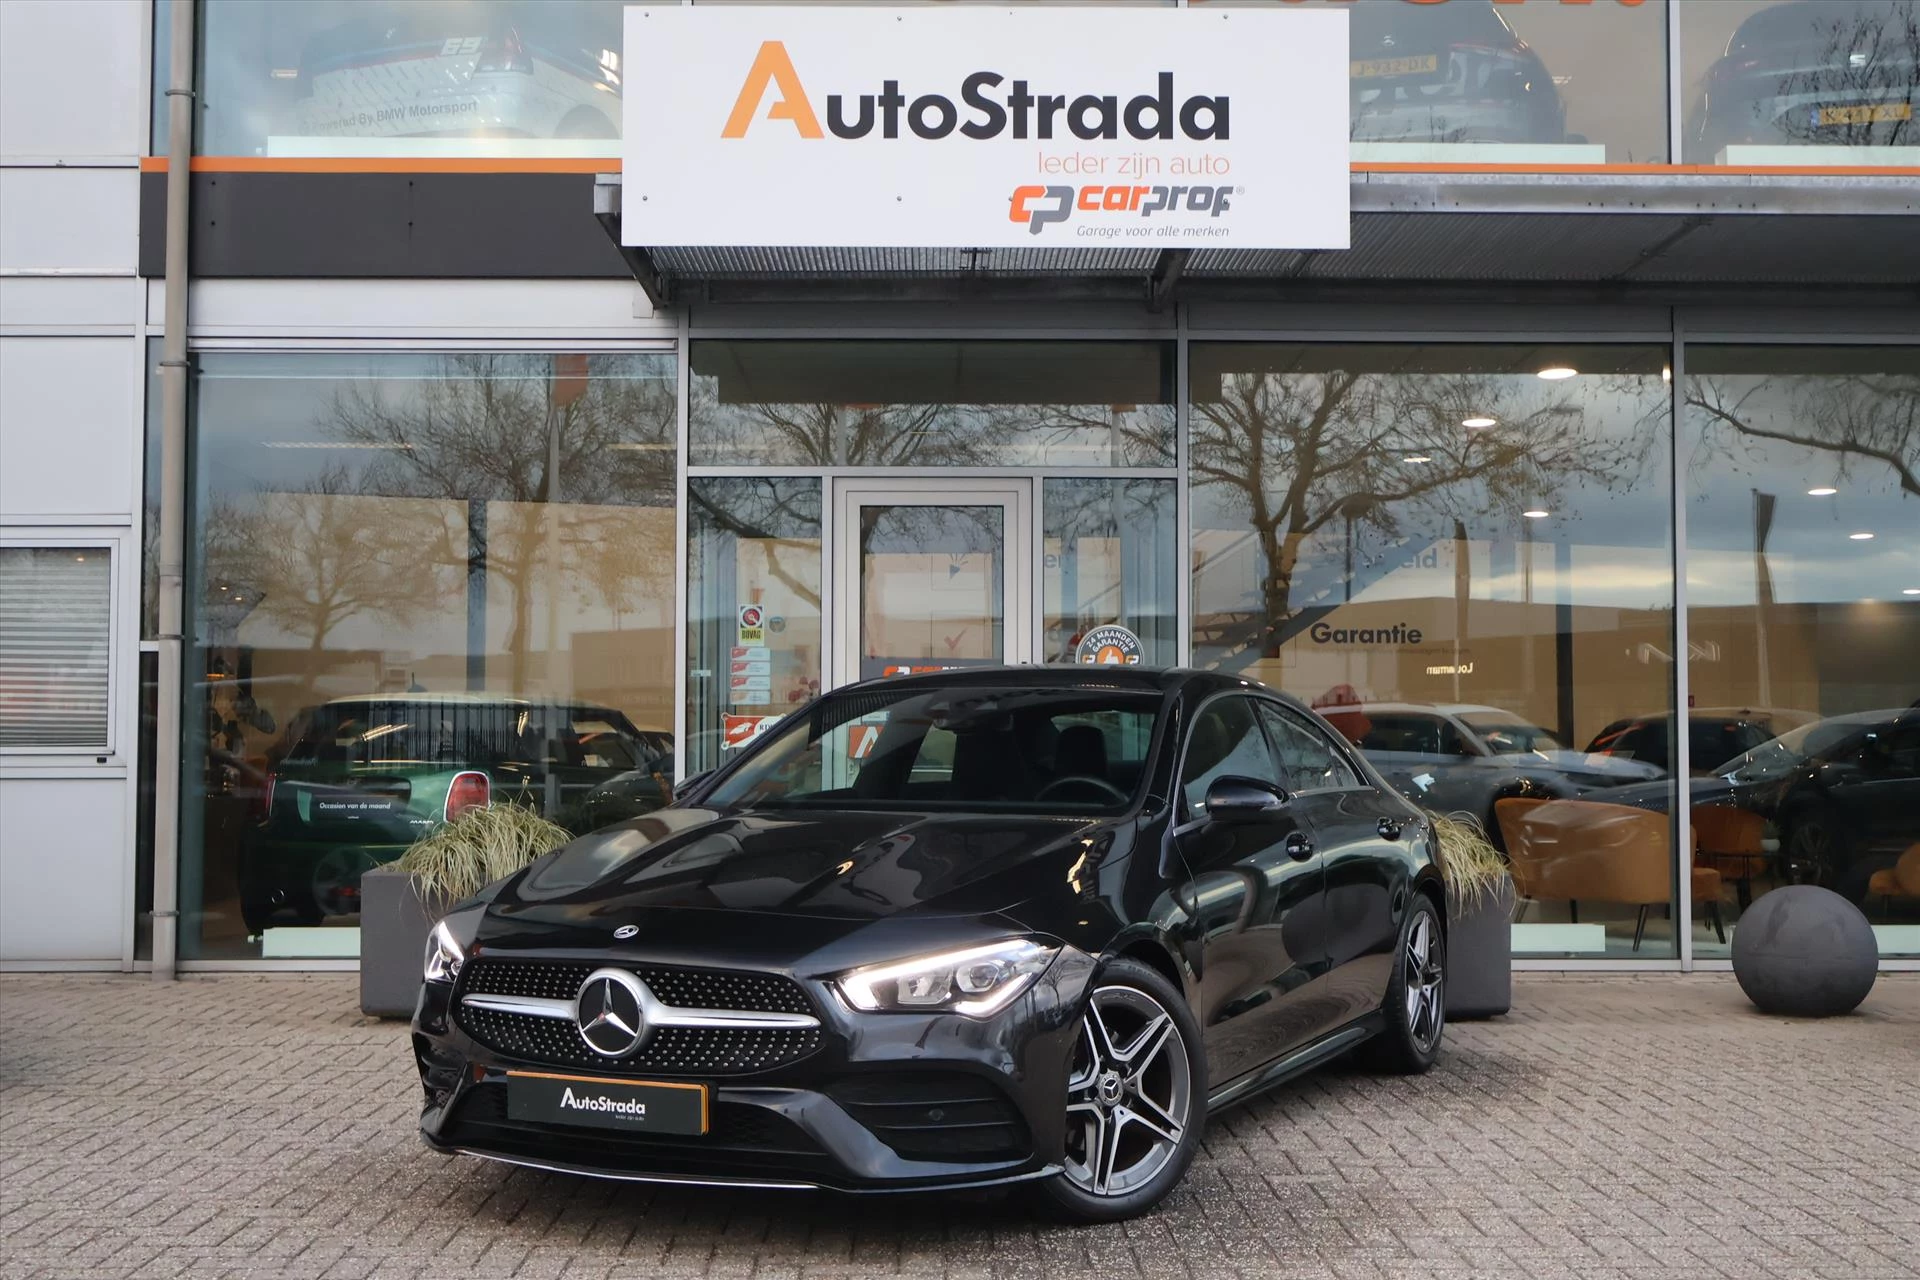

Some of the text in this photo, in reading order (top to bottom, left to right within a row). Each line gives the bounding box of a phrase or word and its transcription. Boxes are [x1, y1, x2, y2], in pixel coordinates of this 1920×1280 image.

[720, 40, 1230, 141] AutoStrada
[359, 111, 375, 126] By
[376, 106, 405, 122] BMW
[408, 100, 478, 119] Motorsport
[1038, 152, 1230, 180] Ieder zijn auto
[1077, 226, 1230, 239] Garage voor alle merken
[741, 629, 761, 640] BOVAG
[1086, 630, 1136, 649] 24 MAANDEN
[1310, 622, 1423, 644] Garantie
[1092, 638, 1130, 654] GARANTIE
[319, 801, 346, 810] Occasion
[360, 801, 368, 810] de
[369, 801, 391, 810] maand
[560, 1087, 646, 1115] AutoStrada
